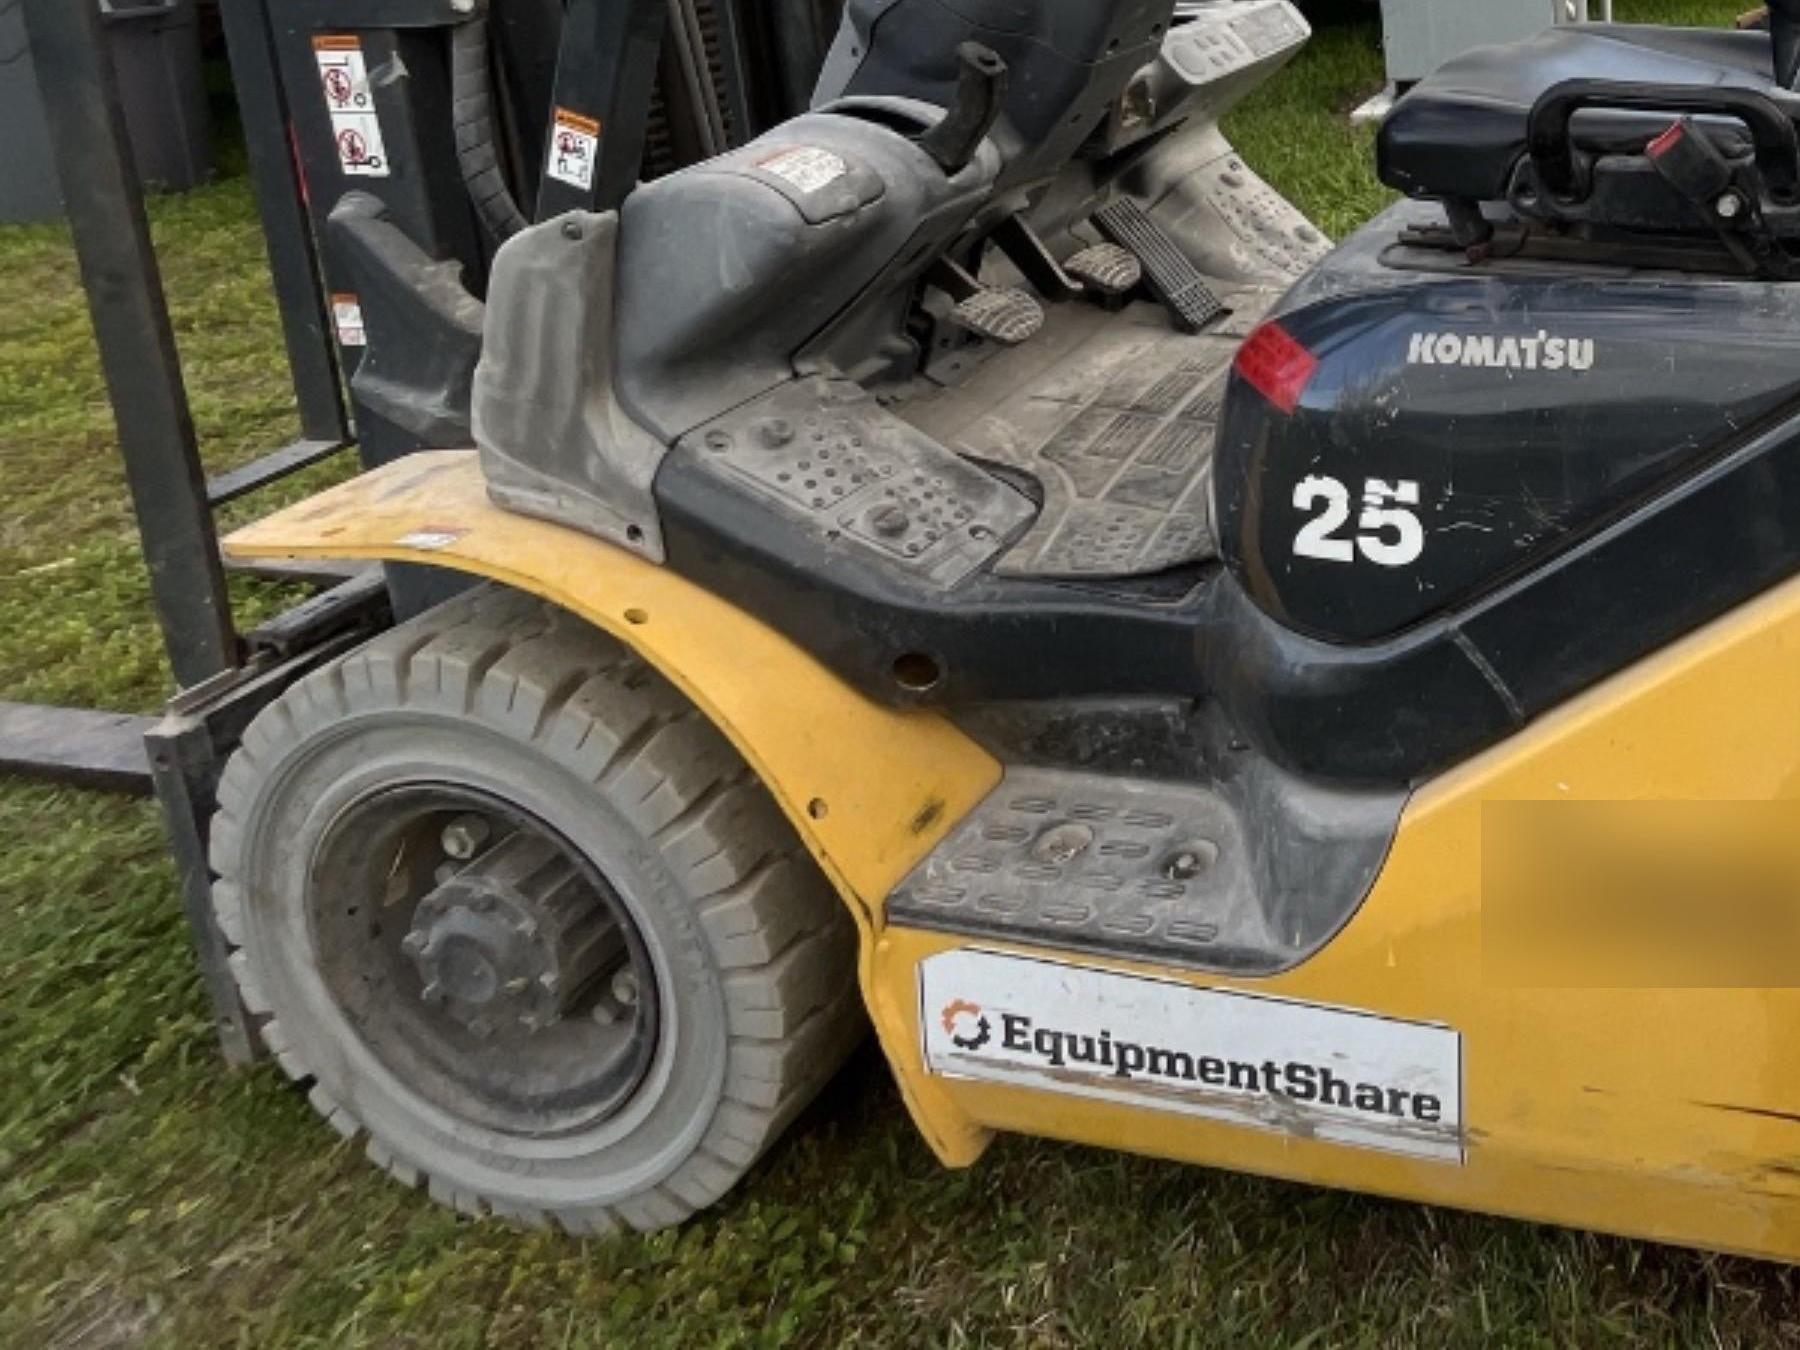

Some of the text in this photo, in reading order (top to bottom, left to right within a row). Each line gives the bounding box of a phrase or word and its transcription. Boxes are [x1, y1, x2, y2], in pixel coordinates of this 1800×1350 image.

[1406, 329, 1594, 370] KOMATSU
[1292, 474, 1424, 567] 25
[1001, 1012, 1441, 1123] EquipmentShare
